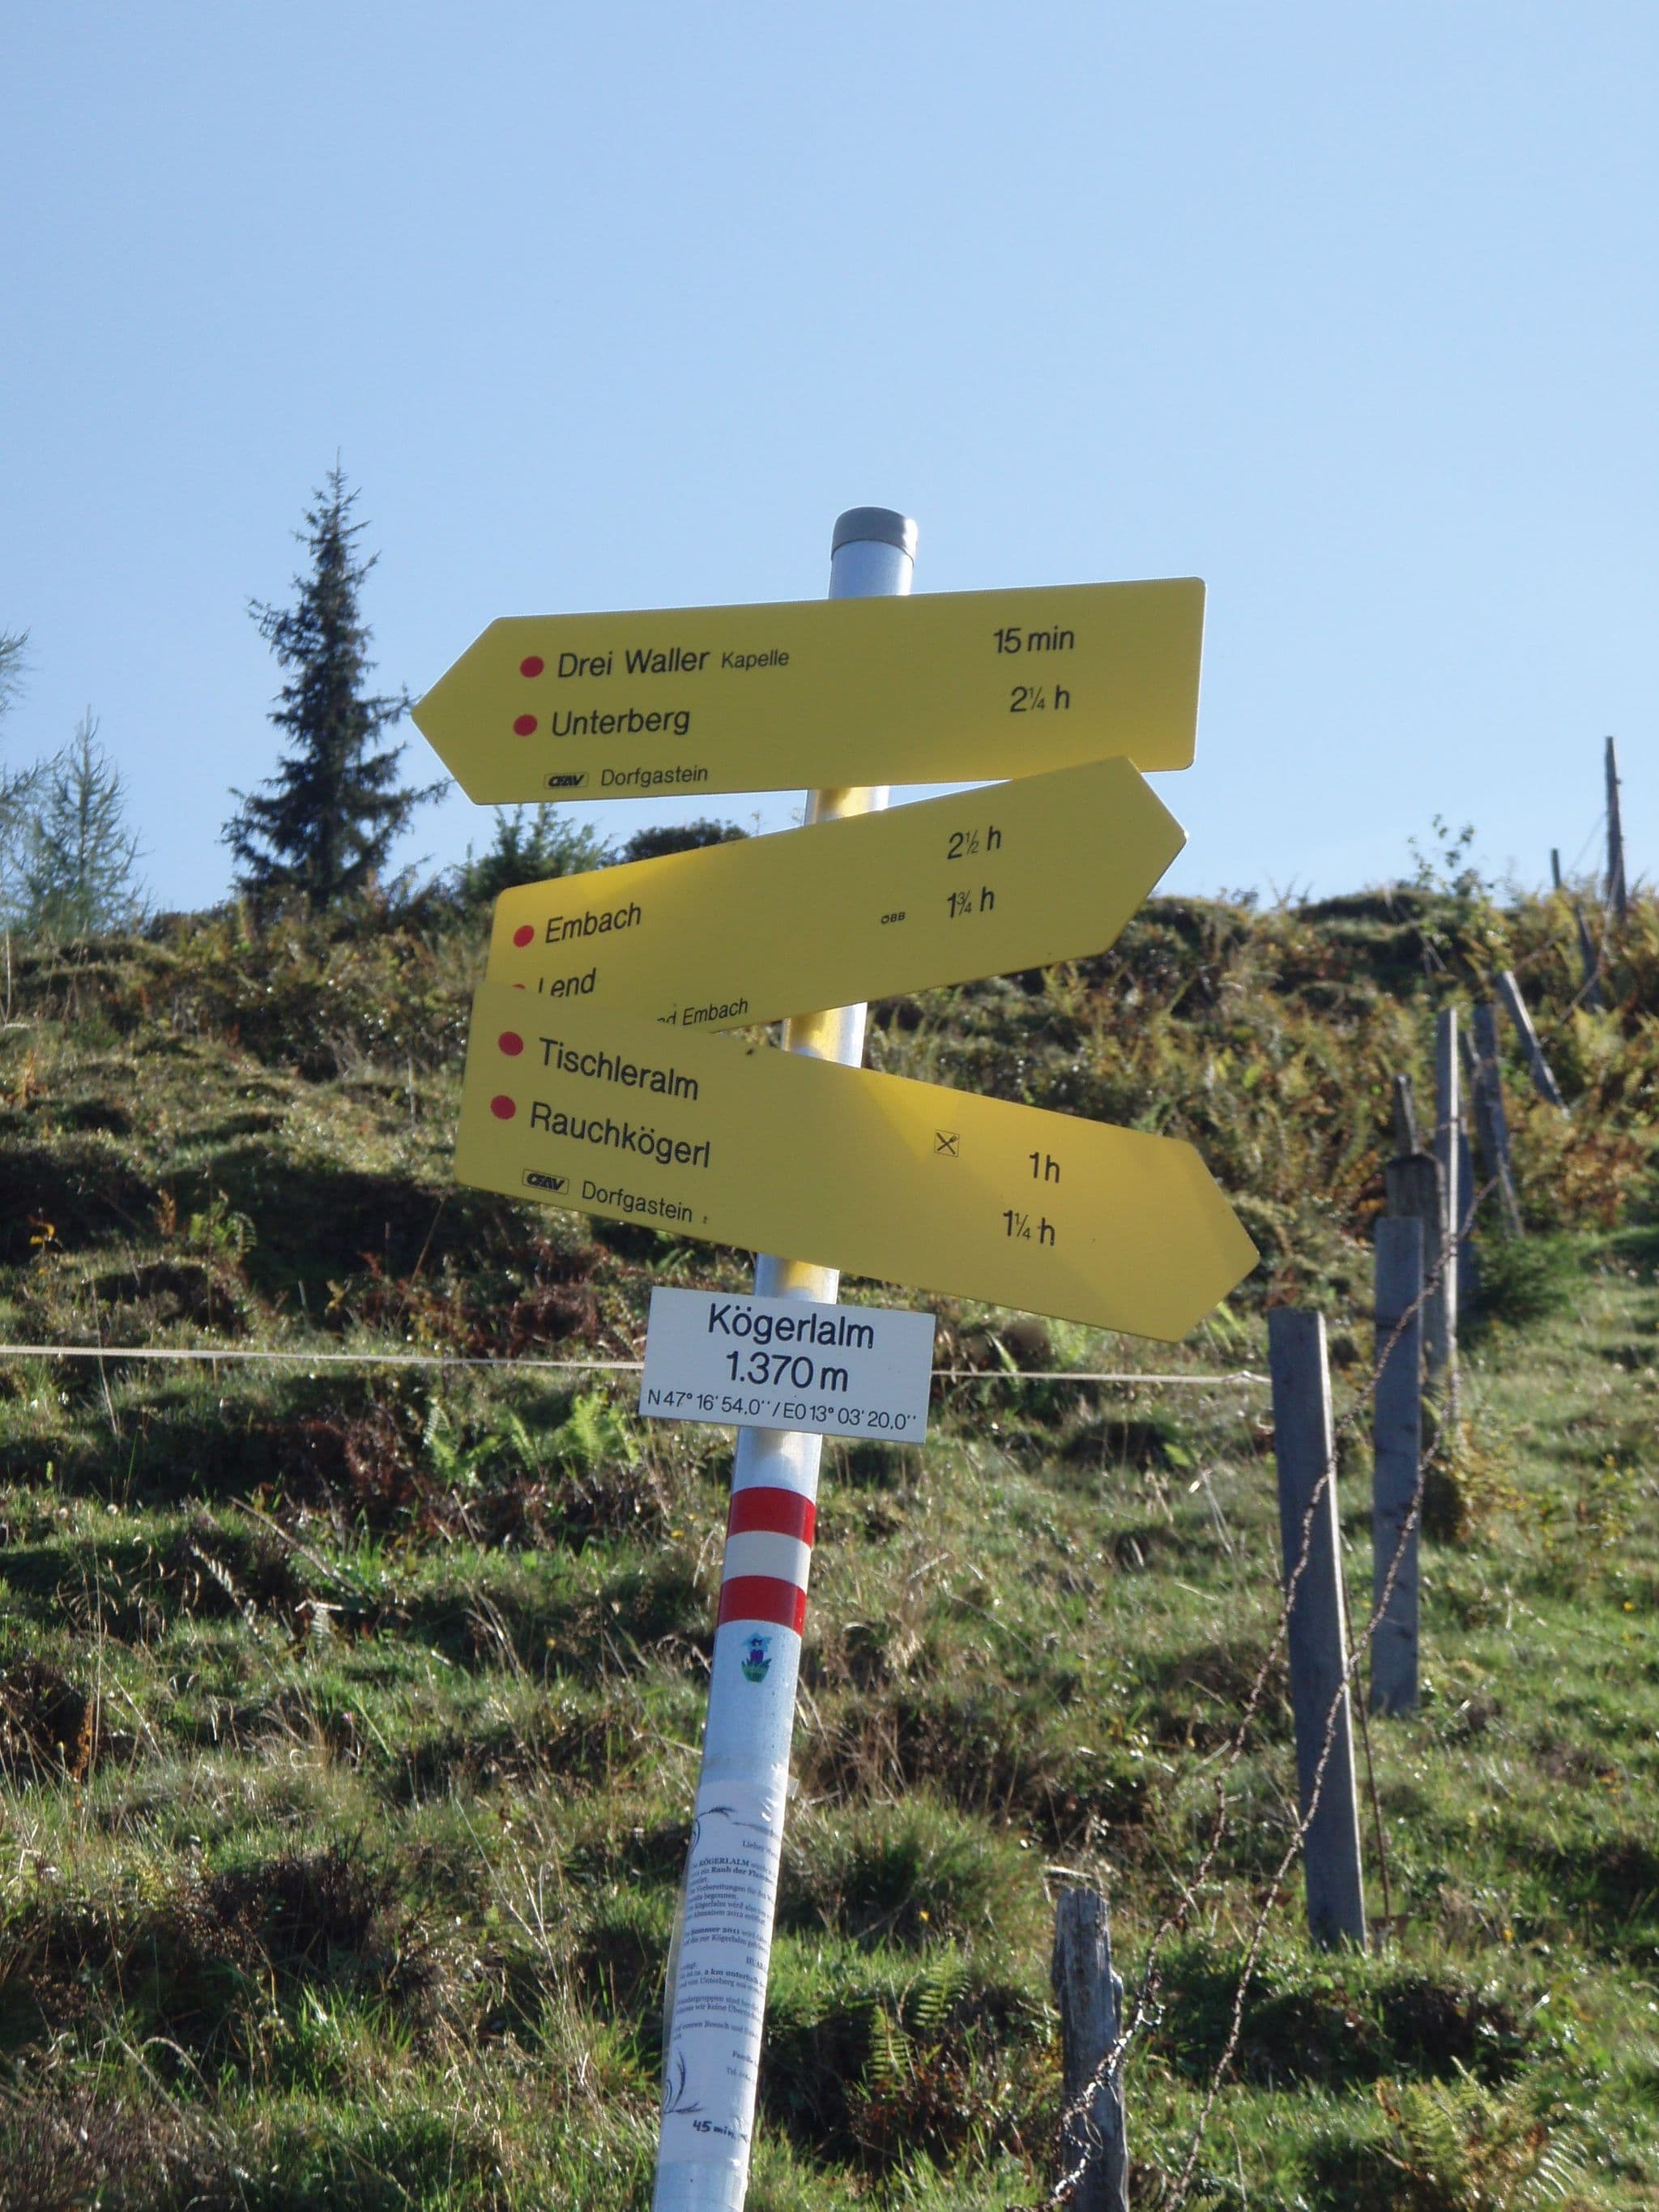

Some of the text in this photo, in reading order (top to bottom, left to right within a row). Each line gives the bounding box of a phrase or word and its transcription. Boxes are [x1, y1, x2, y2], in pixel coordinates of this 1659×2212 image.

[993, 626, 1075, 654] 15 min
[557, 648, 790, 678] Drei Waller Kapelle
[551, 708, 691, 738] Unterberg
[600, 765, 709, 788] Dorfgastein
[545, 902, 642, 944] Embach
[682, 997, 748, 1026] Embach
[539, 1036, 698, 1101] Tischleralm
[530, 1100, 710, 1168] Rauchkögerl
[582, 1180, 693, 1223] Dorfgastein
[708, 1302, 874, 1349] Kögerlalm
[726, 1351, 849, 1392] 1.370 m
[693, 2119, 713, 2133] 45
